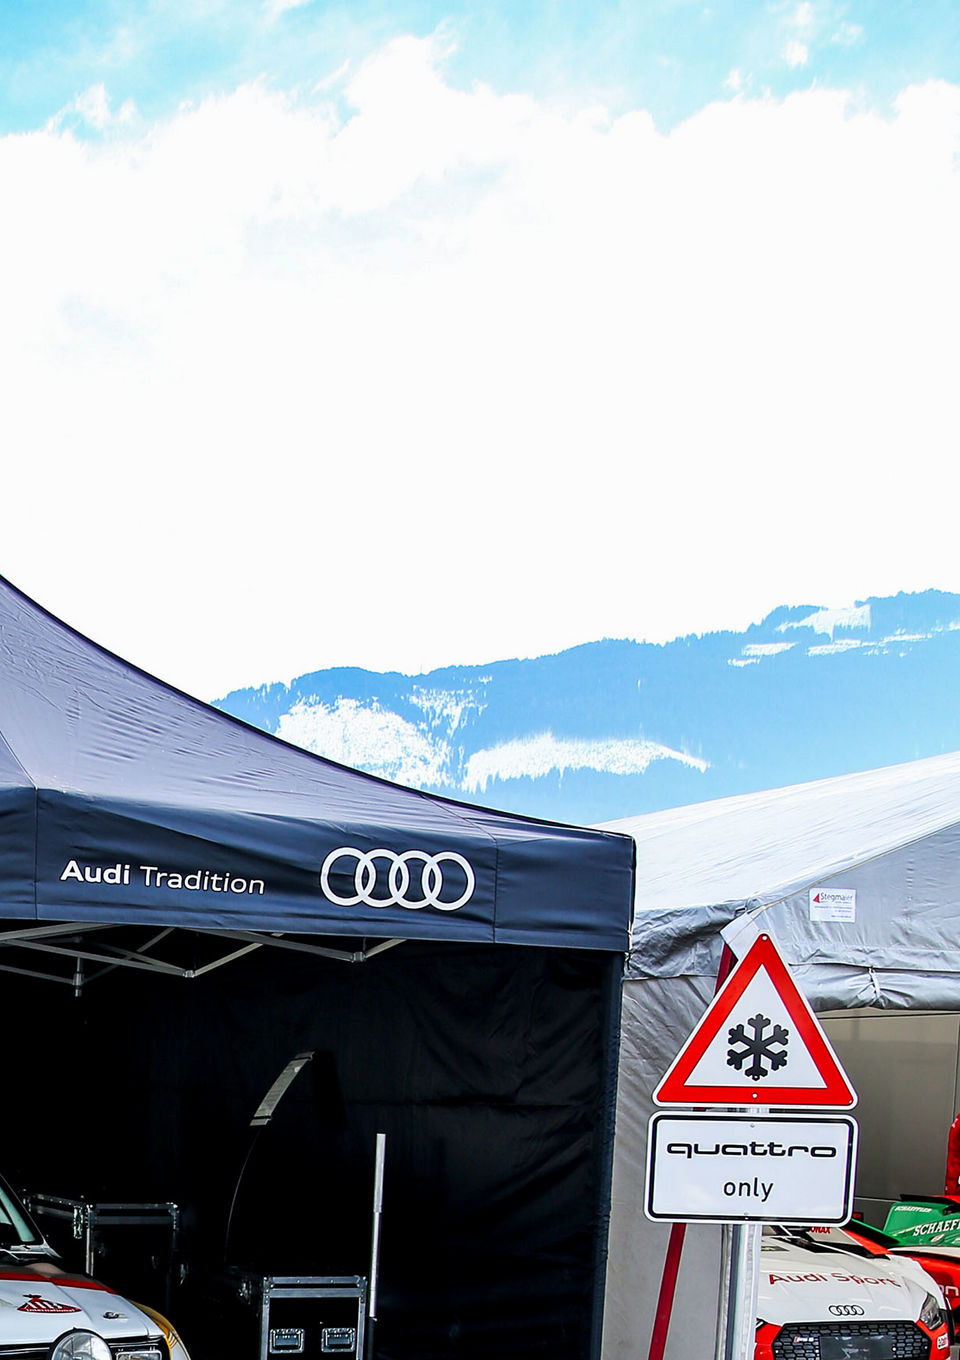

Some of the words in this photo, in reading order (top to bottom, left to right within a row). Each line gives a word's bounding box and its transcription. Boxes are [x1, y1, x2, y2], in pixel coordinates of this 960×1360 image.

[60, 860, 131, 885] Audi
[140, 865, 265, 895] Tradition
[667, 1142, 836, 1158] quattro
[723, 1177, 774, 1203] only
[912, 1218, 960, 1237] SCHAEF
[769, 1273, 828, 1285] Audi
[831, 1272, 902, 1288] Sport
